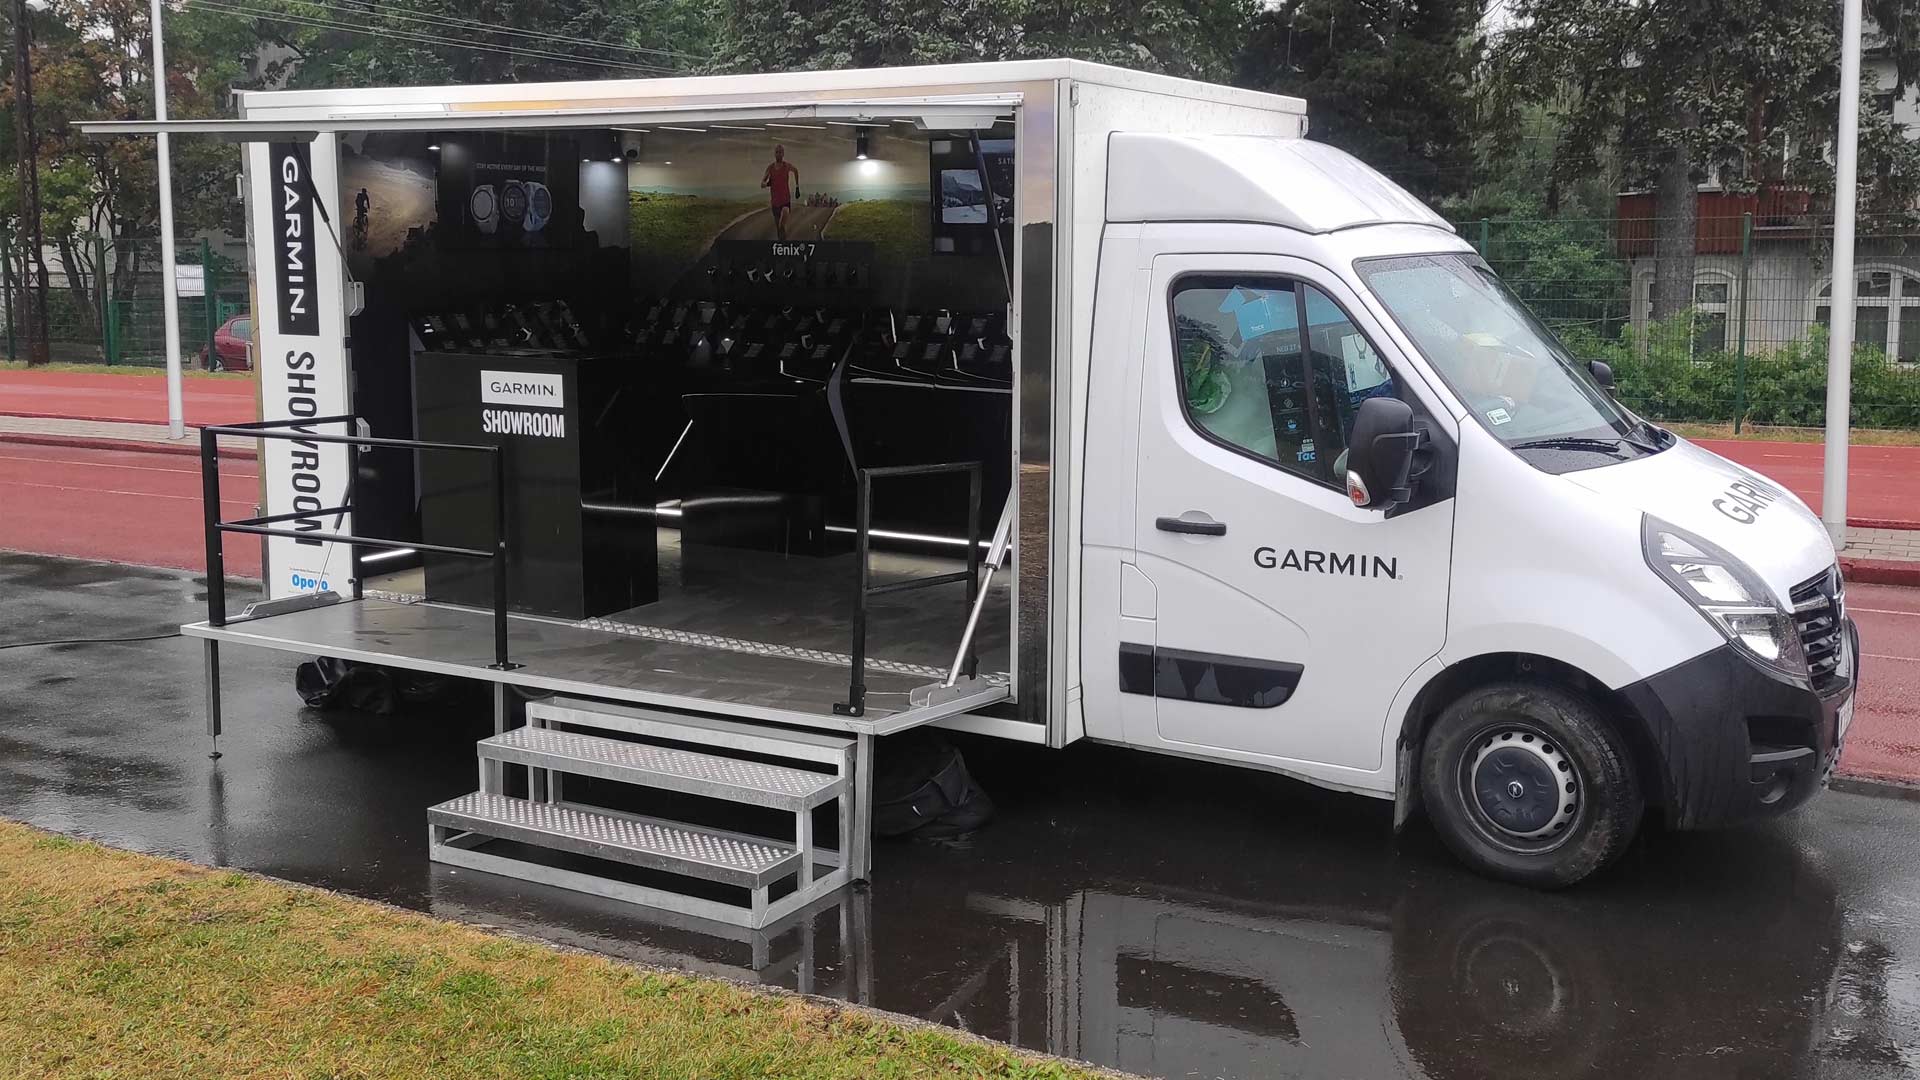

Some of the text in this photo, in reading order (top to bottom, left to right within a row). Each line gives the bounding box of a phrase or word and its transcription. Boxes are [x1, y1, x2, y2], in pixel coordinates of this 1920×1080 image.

[283, 155, 306, 314] GARMIN
[808, 243, 816, 256] 7
[491, 381, 554, 396] GARMIN
[482, 409, 565, 438] SHOWROOM
[1253, 546, 1397, 580] GARMIN
